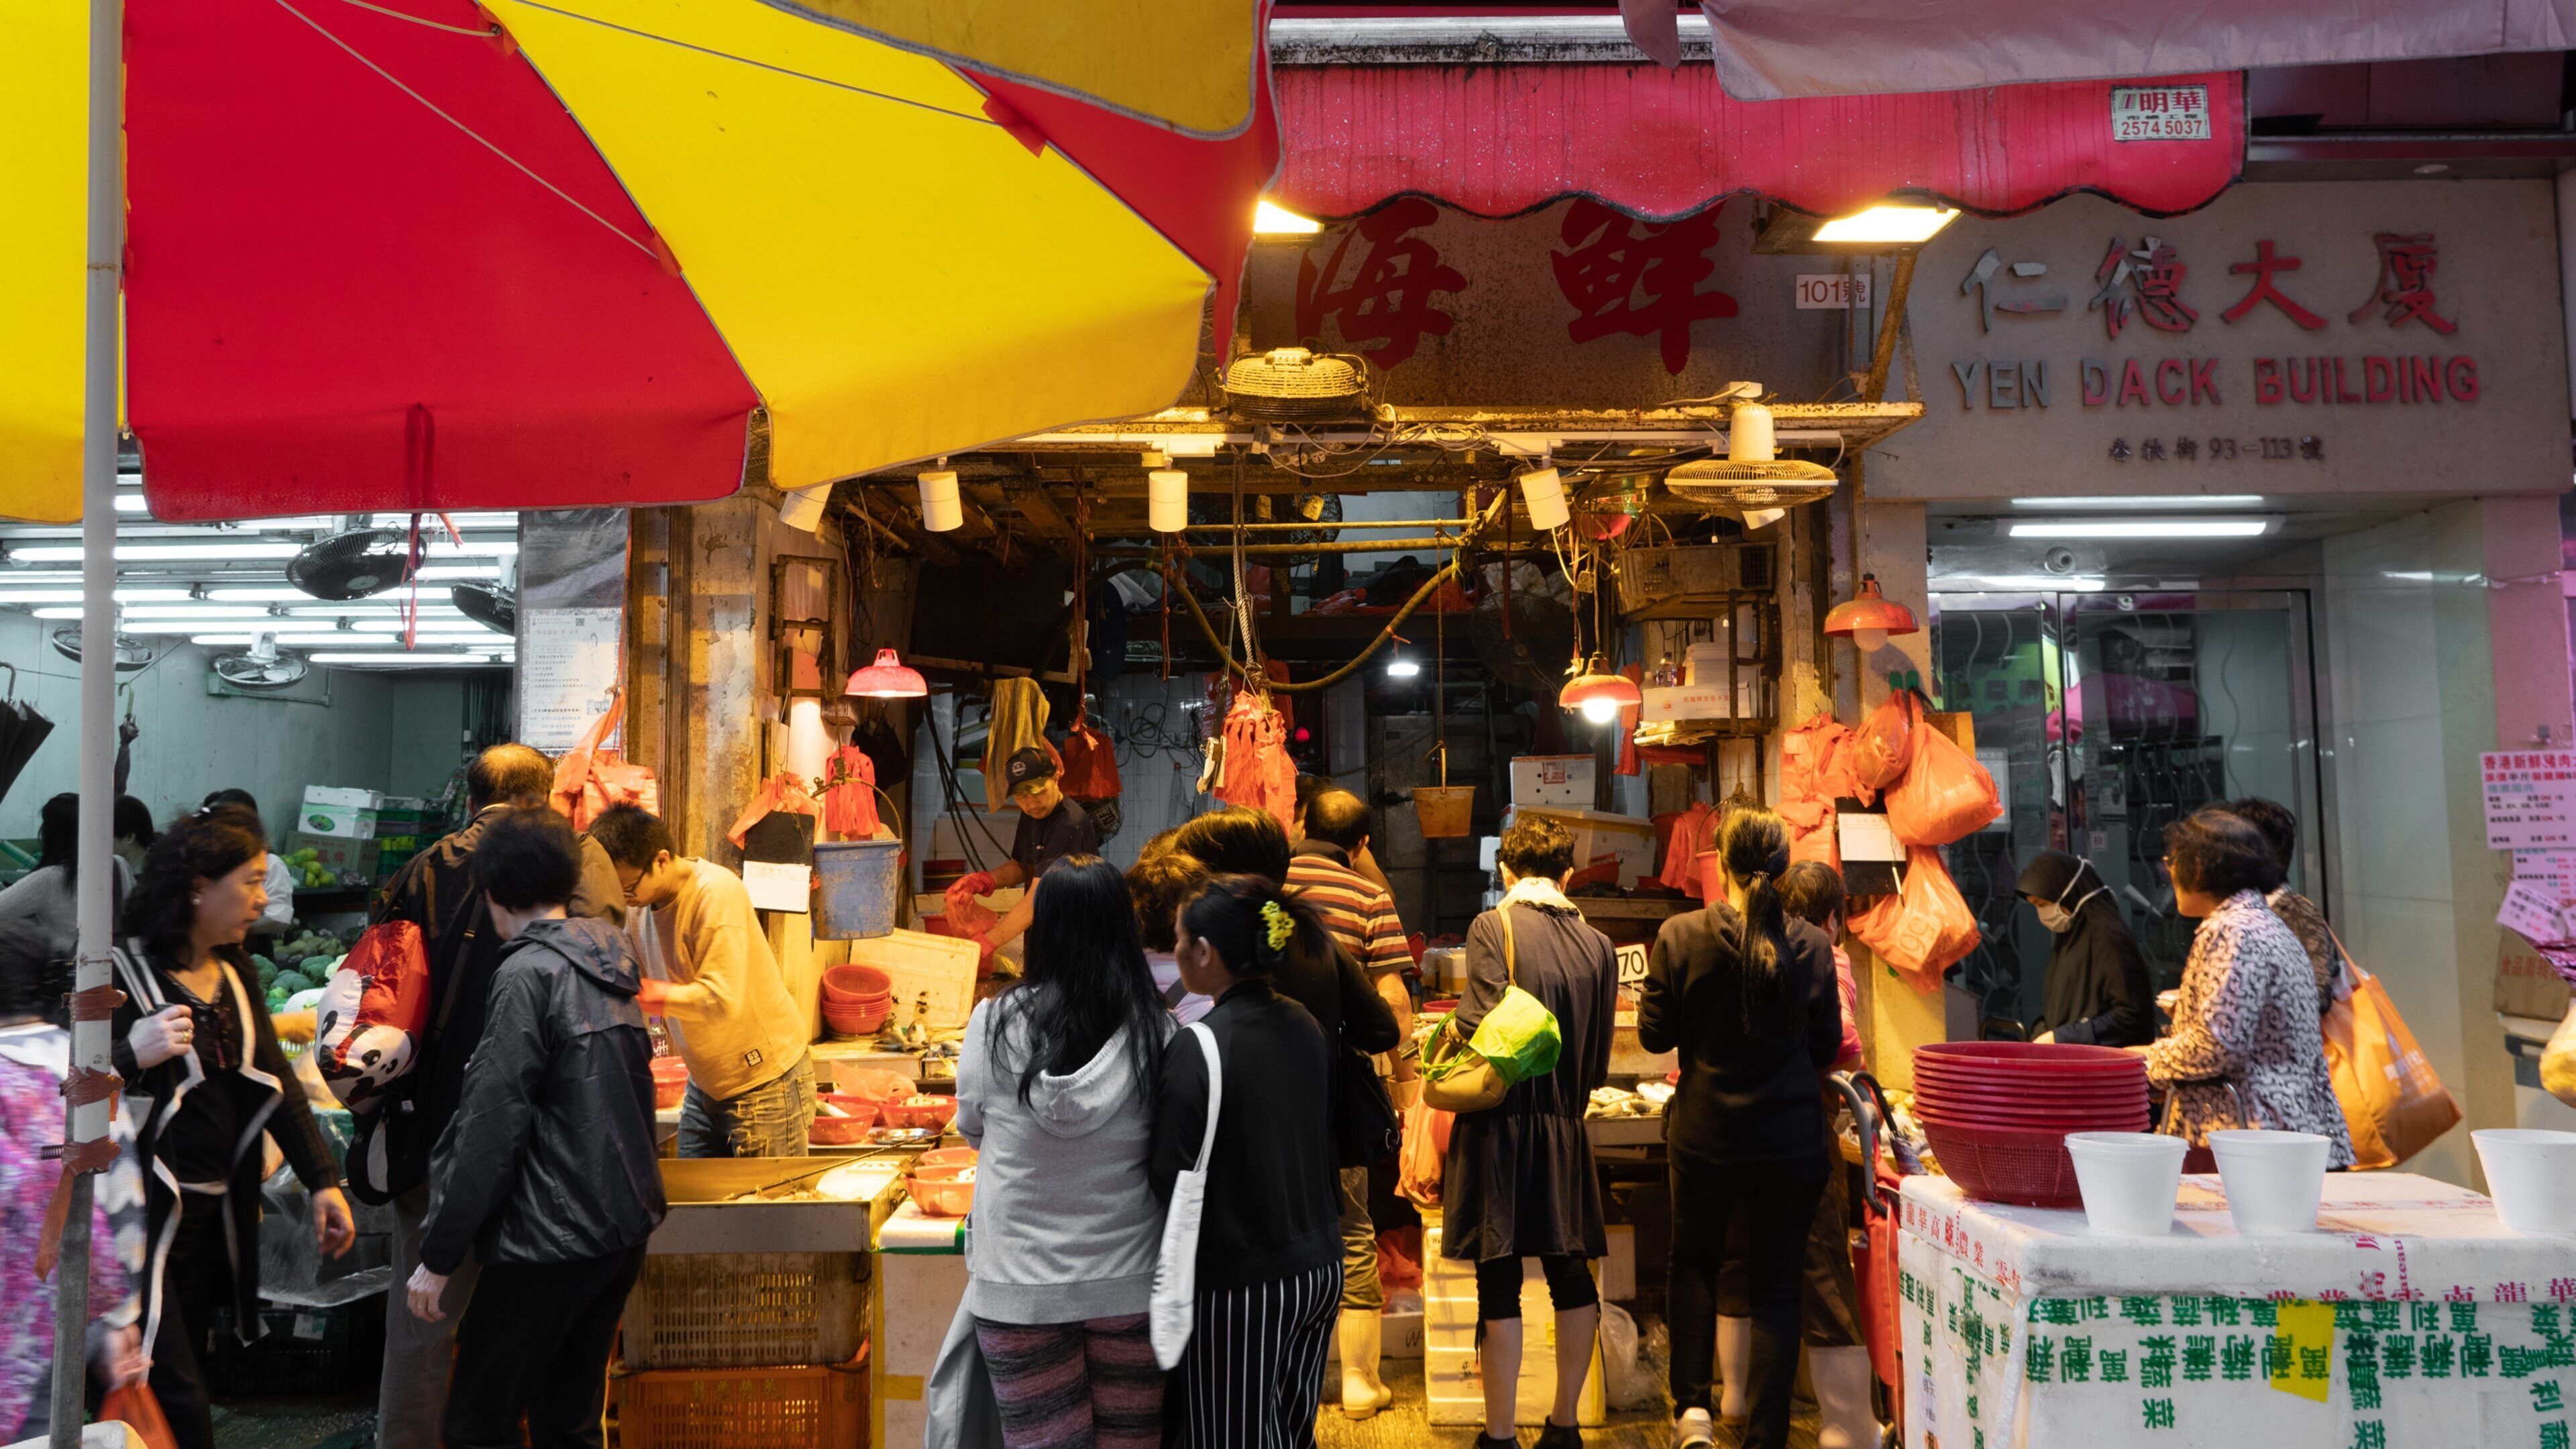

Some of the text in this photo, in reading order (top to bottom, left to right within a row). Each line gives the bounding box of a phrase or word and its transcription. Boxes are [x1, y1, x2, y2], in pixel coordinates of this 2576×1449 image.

[2139, 91, 2202, 113] 明華
[2121, 120, 2202, 136] 2574 5037
[1960, 231, 2457, 338] 仁德大廈
[1952, 355, 2481, 410] YEN DACK BUILDING
[2485, 753, 2576, 769] 香港新鮮豬肉
[1617, 951, 1644, 976] 70
